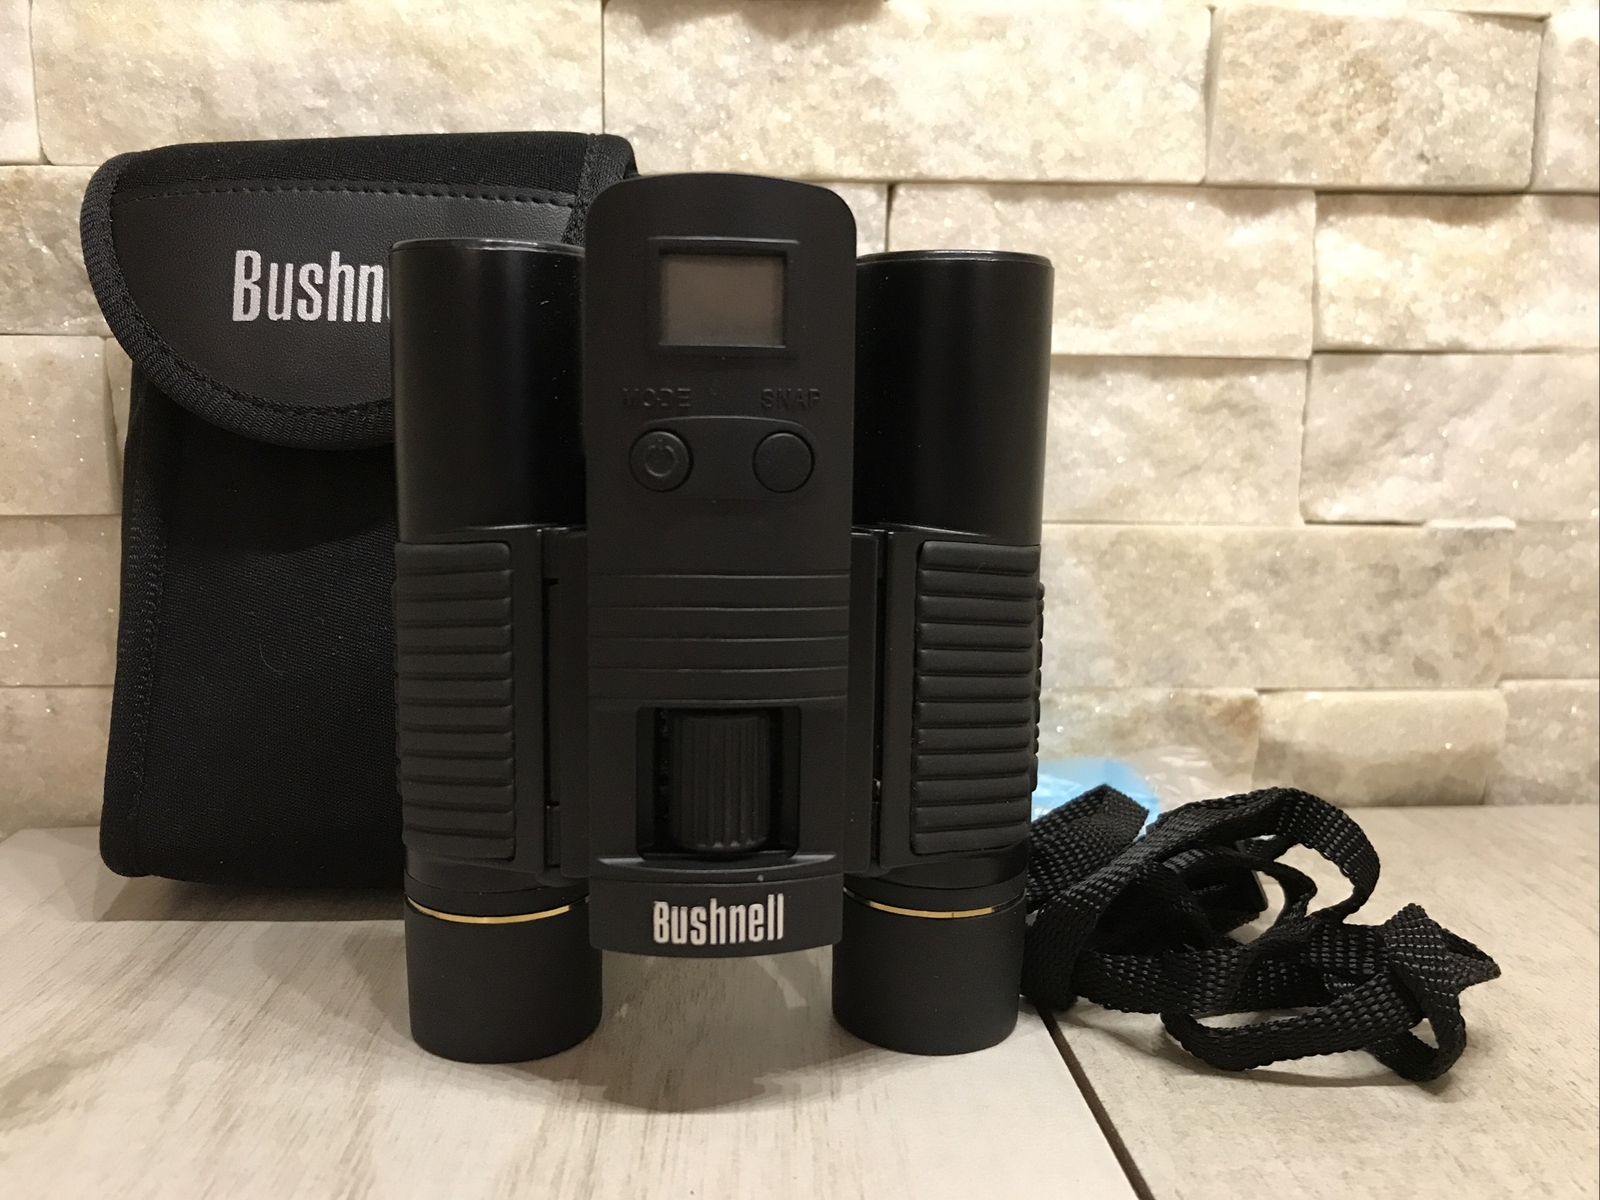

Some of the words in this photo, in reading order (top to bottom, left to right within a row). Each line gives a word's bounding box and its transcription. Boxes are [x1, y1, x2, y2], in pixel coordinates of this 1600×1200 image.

[232, 250, 390, 323] Bushn
[622, 387, 692, 408] MODE
[760, 387, 822, 409] SNAP
[653, 893, 784, 945] Bushnell
